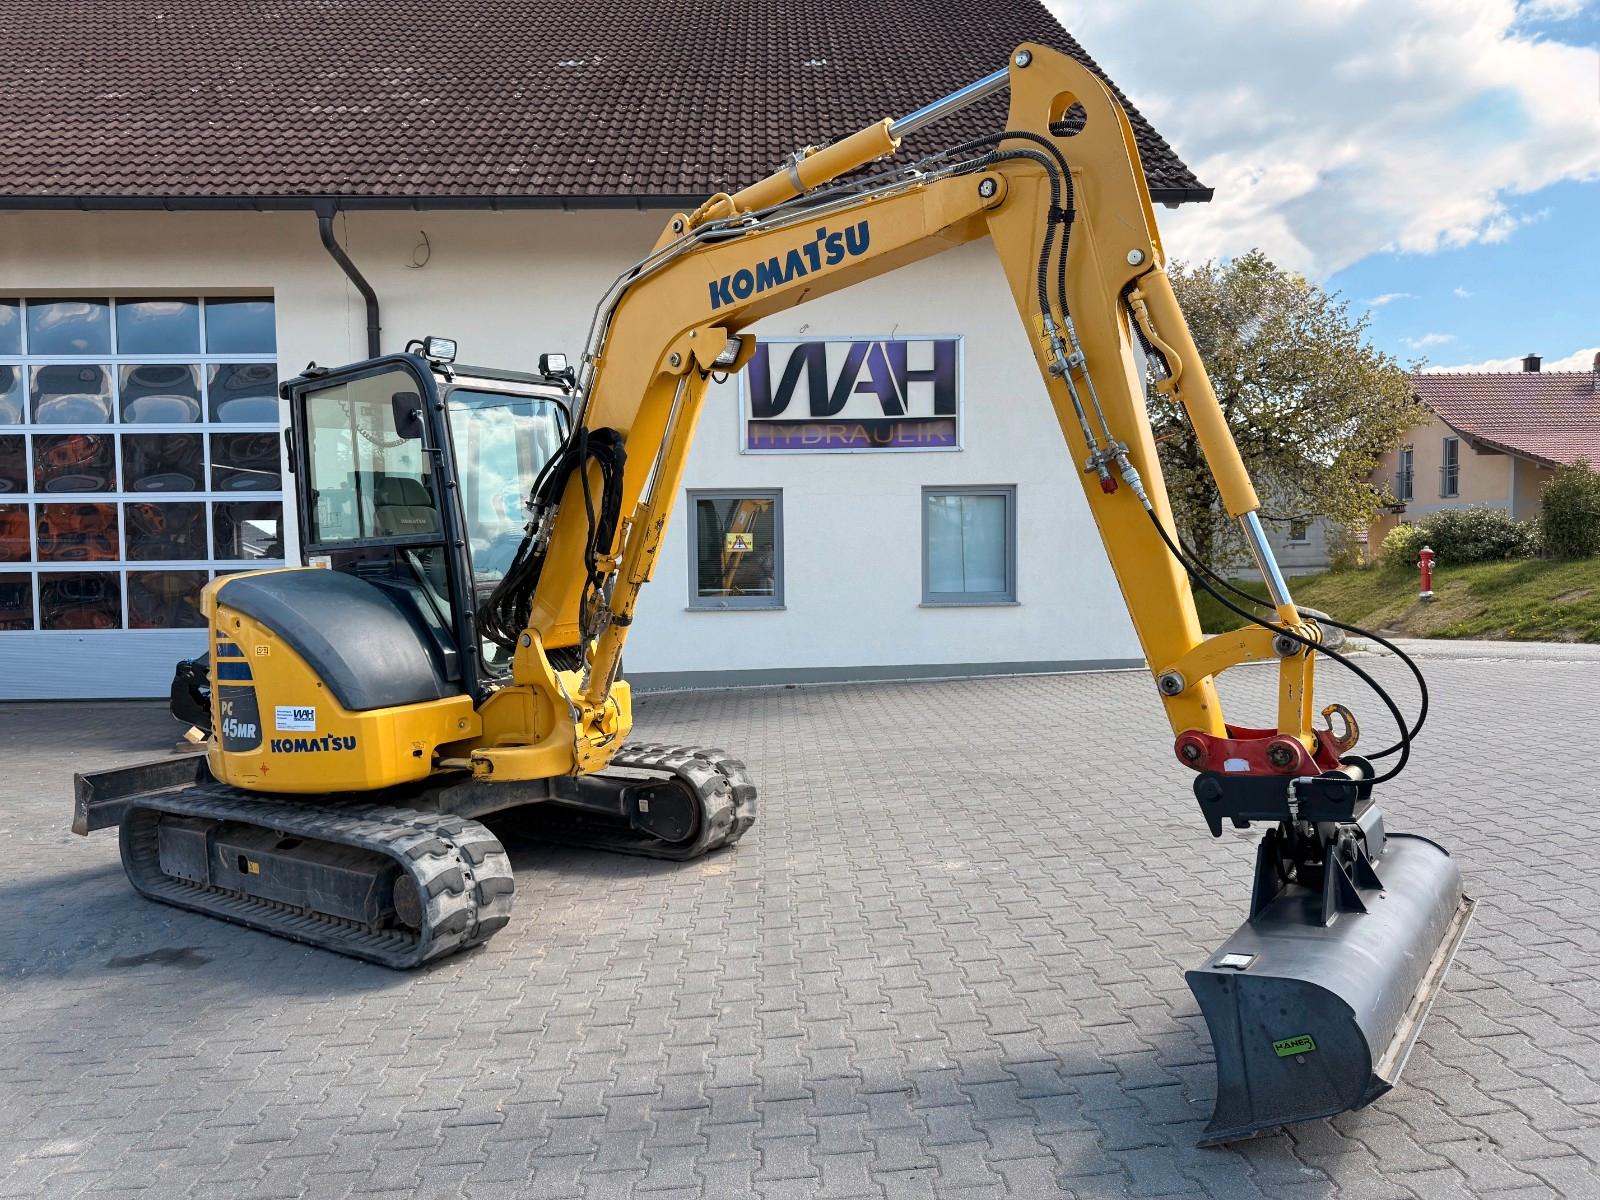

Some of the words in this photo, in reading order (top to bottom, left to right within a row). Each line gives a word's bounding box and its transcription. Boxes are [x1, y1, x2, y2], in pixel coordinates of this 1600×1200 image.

[708, 220, 870, 310] KOMATSU
[748, 340, 956, 418] WAH
[753, 422, 947, 445] HYDRAULIK
[221, 701, 233, 716] PC
[222, 718, 256, 739] 45MR
[270, 733, 356, 753] KOMATSU
[1275, 1037, 1312, 1050] HÄNER
